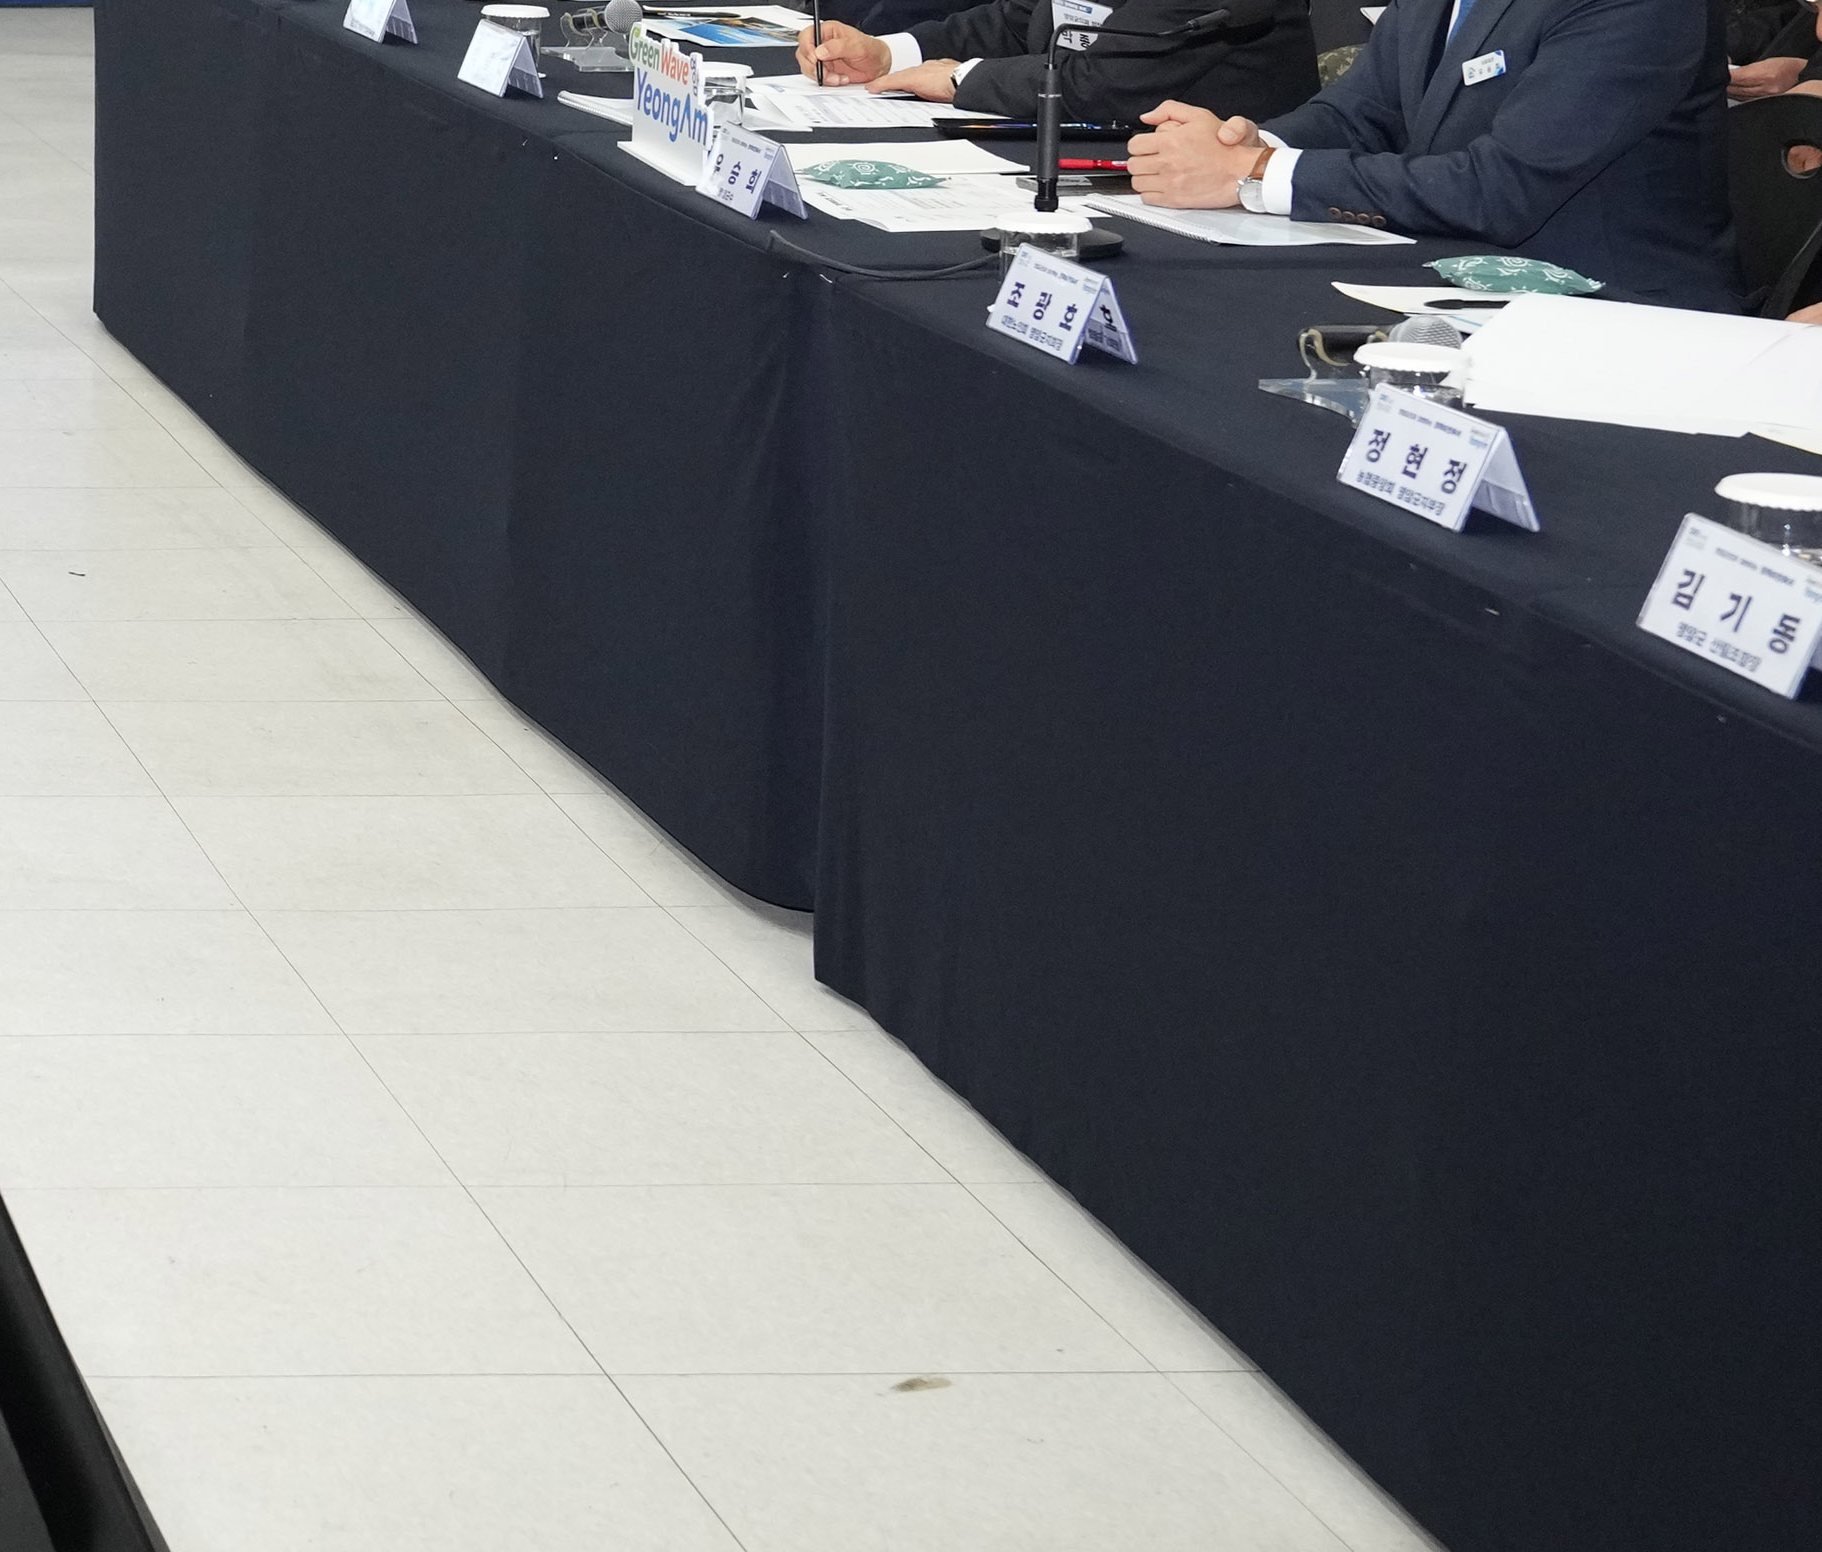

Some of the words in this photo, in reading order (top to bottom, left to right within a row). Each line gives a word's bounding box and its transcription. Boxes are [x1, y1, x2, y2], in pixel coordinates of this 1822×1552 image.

[630, 27, 660, 71] Green
[661, 43, 690, 86] Wave
[636, 67, 709, 147] YeongAm
